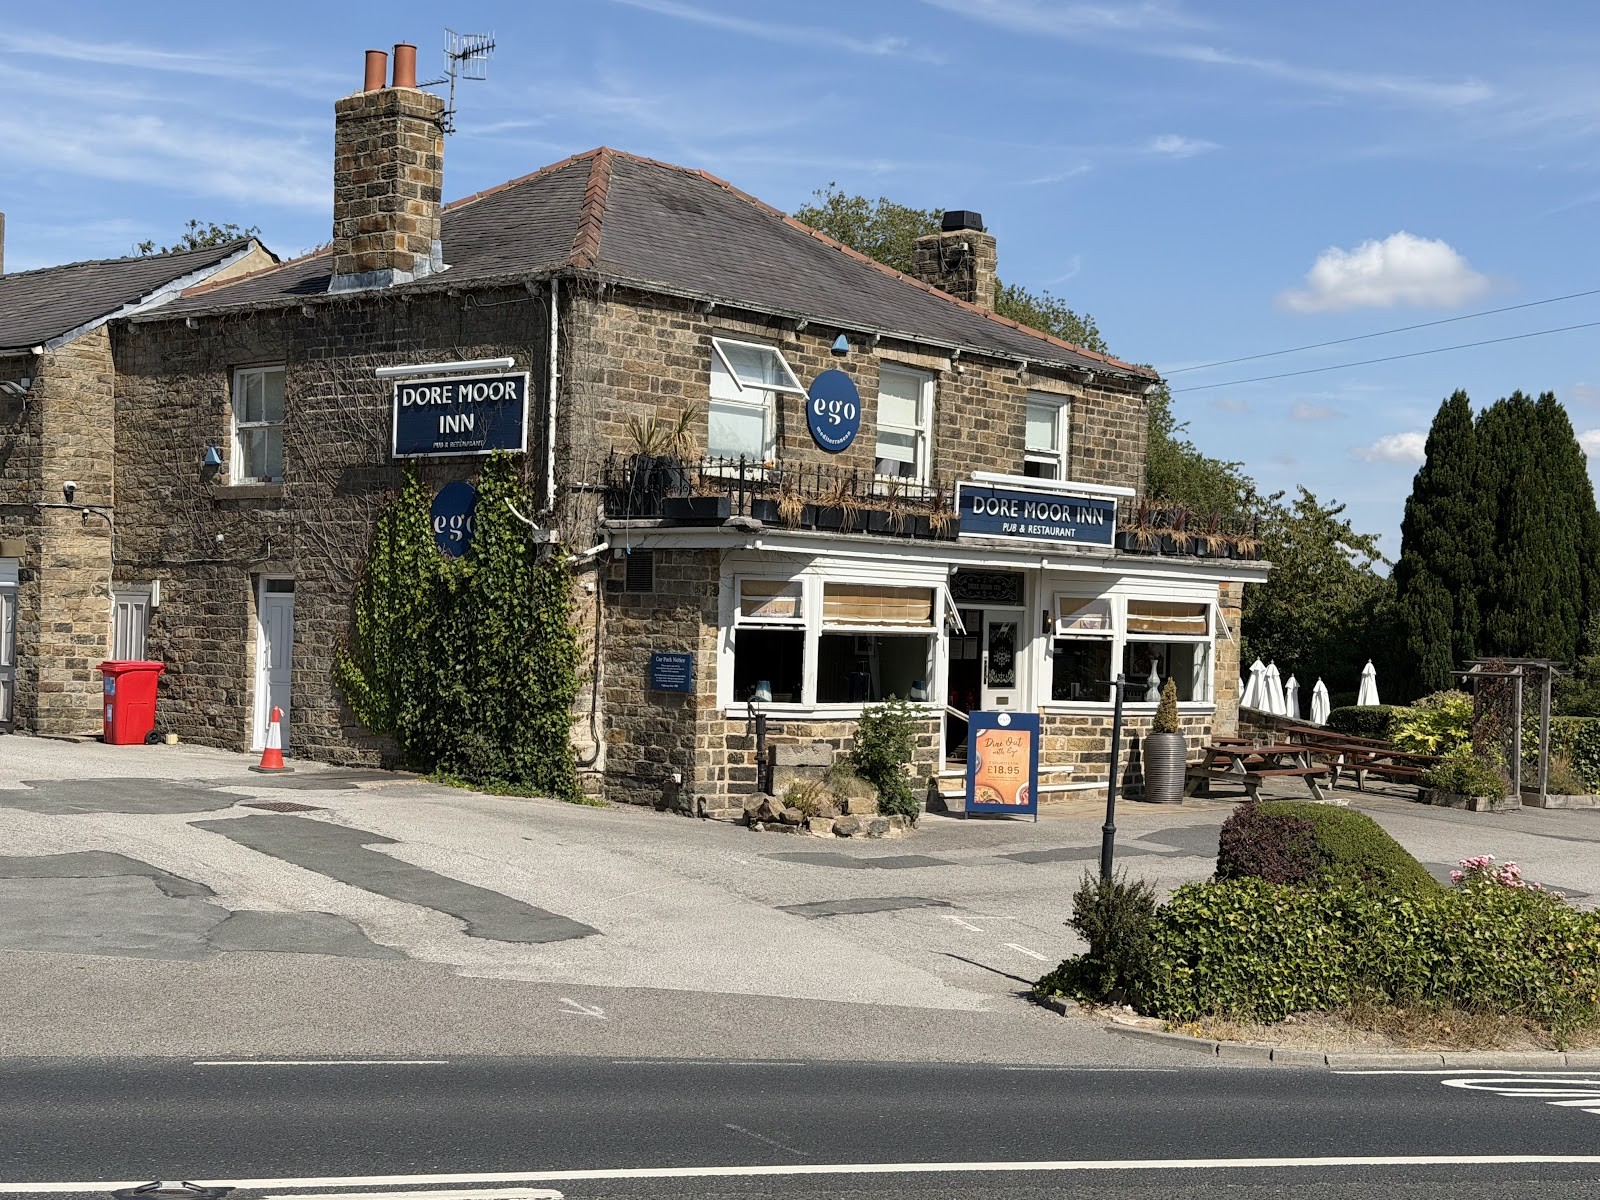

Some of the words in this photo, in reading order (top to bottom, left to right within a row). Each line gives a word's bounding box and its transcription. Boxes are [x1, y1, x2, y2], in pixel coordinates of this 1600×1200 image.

[402, 385, 453, 407] DORE
[458, 381, 517, 403] MOOR
[813, 398, 856, 426] ego
[439, 413, 475, 434] INN
[972, 496, 1019, 517] DORE
[1024, 501, 1071, 522] MOOR
[1076, 507, 1104, 526] INN
[1002, 522, 1018, 533] PUB
[1018, 524, 1026, 534] &
[1027, 524, 1076, 538] RESTAURANT
[984, 737, 1004, 748] Dine
[1005, 736, 1024, 748] Out
[987, 765, 1020, 775] £18.95
